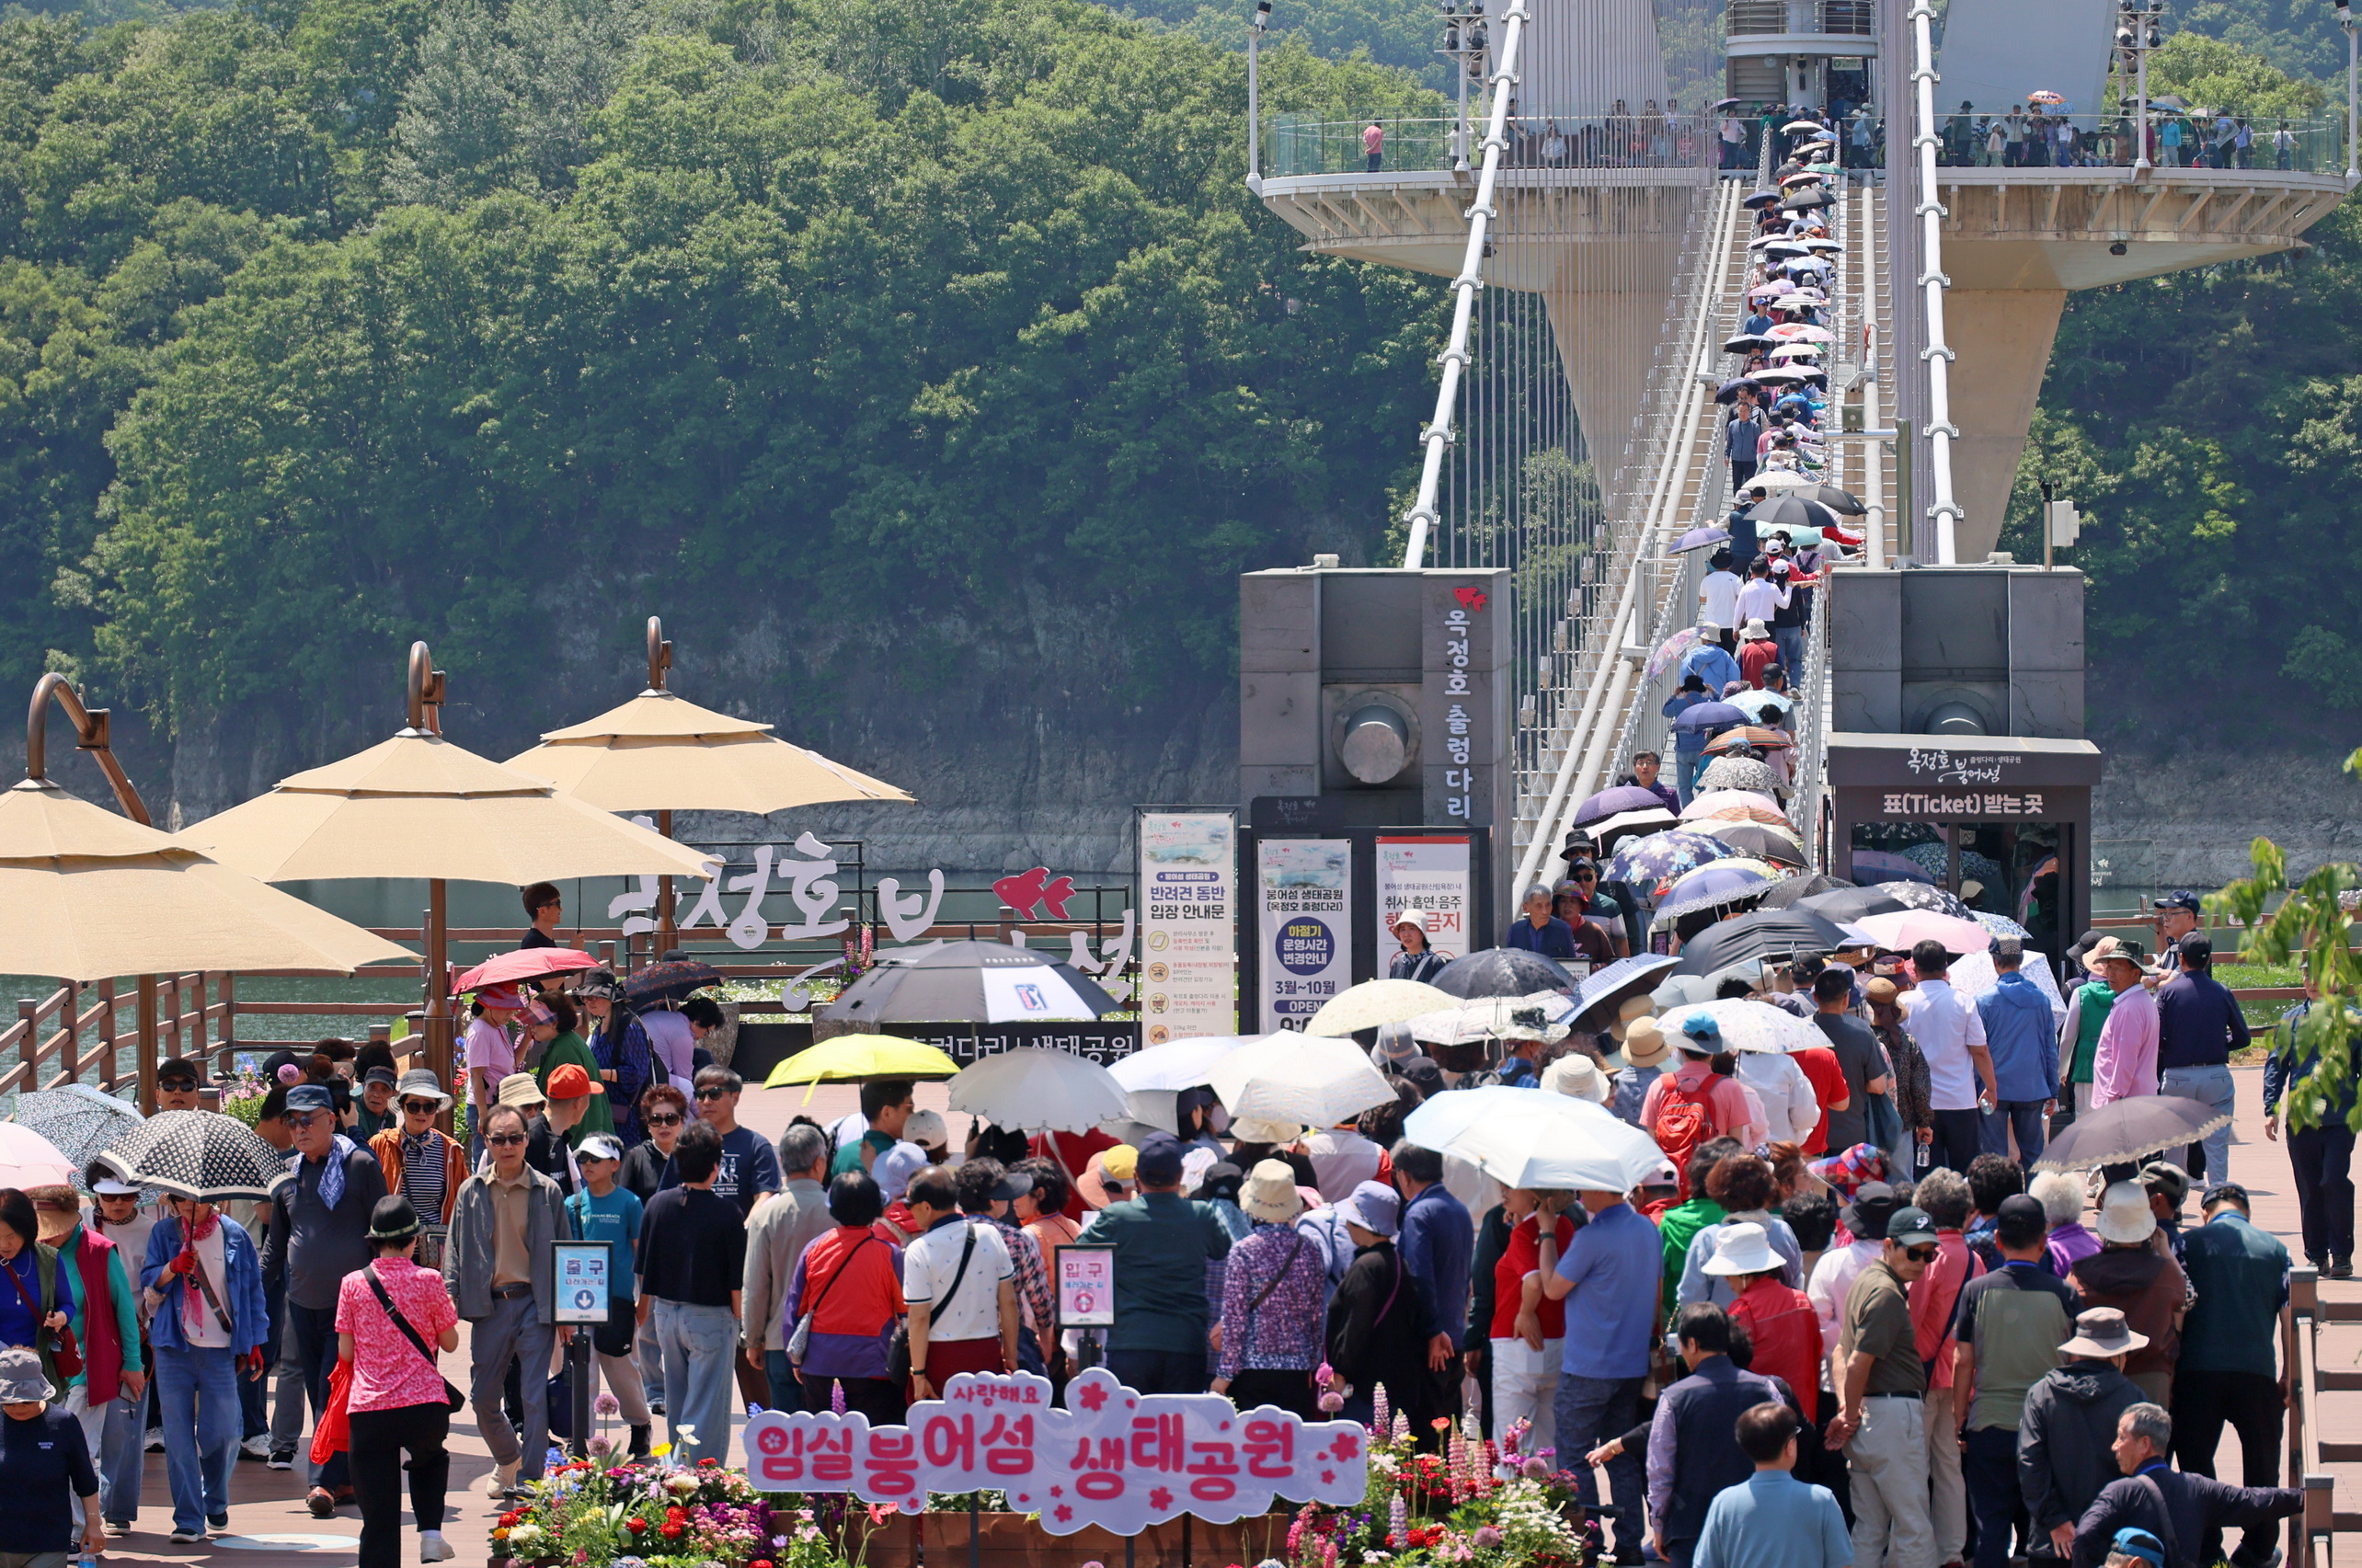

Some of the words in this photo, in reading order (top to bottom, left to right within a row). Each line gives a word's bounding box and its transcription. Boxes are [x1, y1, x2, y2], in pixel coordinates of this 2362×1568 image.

[1445, 610, 1471, 695] 옥정호
[1445, 704, 1473, 819] 출렁다리
[1908, 747, 1950, 774] 옥정호
[1969, 756, 1994, 764] 출렁다리
[1997, 756, 2022, 764] 생태공원
[1937, 758, 2001, 784] 붕어섬
[1883, 794, 1981, 814] 표(Ticket)
[1984, 794, 2022, 814] 받는
[2024, 794, 2044, 814] 곳
[608, 815, 850, 949] 정호
[1151, 886, 1193, 901] 반려견
[1197, 886, 1225, 901] 동반
[1267, 889, 1298, 899] 붕어섬
[1301, 889, 1343, 899] 생태공원
[1151, 904, 1179, 920] 입장
[1182, 904, 1224, 920] 안내문
[1267, 901, 1299, 911] (옥정호
[1301, 901, 1343, 911] 출렁다리)
[1385, 911, 1461, 933] 행금지
[1288, 925, 1322, 937] 하절기
[1283, 939, 1327, 951] 운영시간
[1283, 953, 1327, 965] 변경안내
[1275, 980, 1336, 994] 3월~10월
[1289, 1001, 1323, 1012] OPEN
[953, 1383, 1040, 1406] 사랑해요
[757, 1425, 854, 1482] 임실
[865, 1413, 1034, 1496] 붕어섬
[1070, 1413, 1295, 1502] 생태공원
